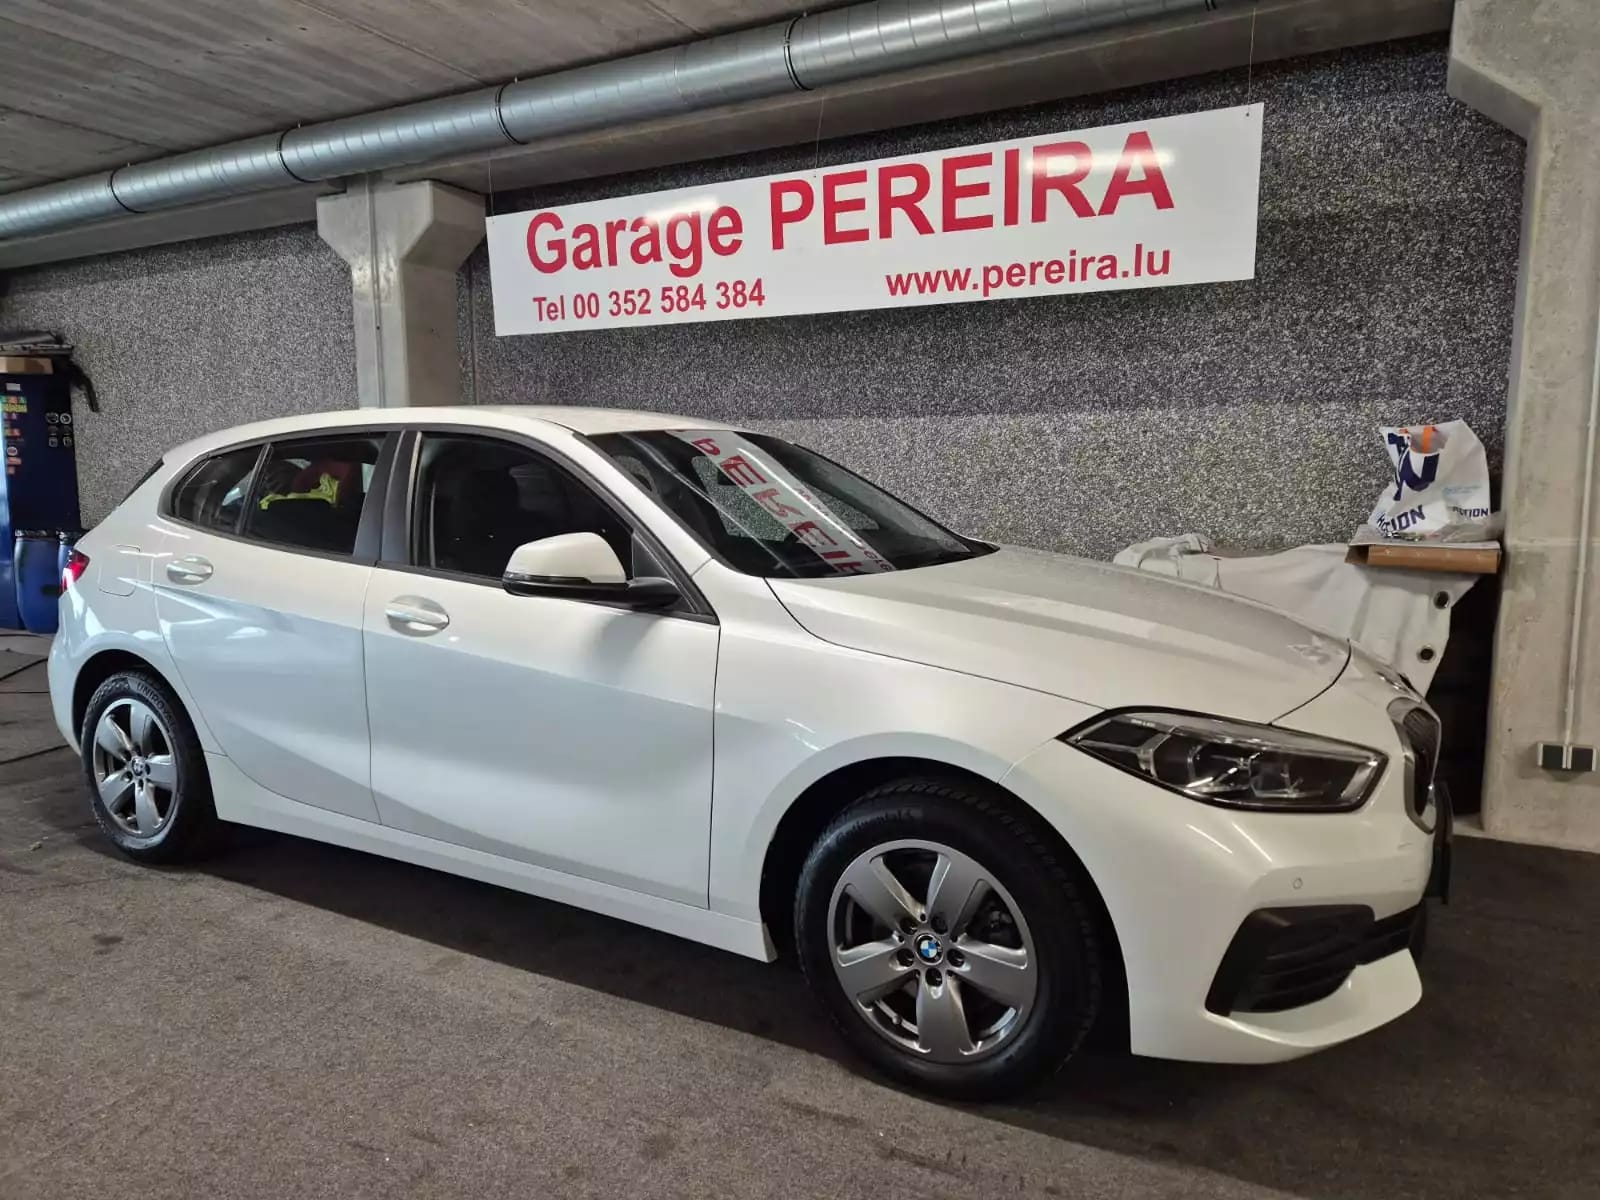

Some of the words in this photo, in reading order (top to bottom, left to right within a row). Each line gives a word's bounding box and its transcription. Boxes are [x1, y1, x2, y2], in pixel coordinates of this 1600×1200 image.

[527, 205, 743, 276] Garage
[770, 131, 1174, 250] PEREIRA
[886, 243, 1171, 297] www.pereira.lu
[533, 295, 566, 320] Tel
[573, 293, 600, 319] 00
[608, 288, 652, 317] 352
[661, 284, 706, 313] 584
[716, 278, 765, 309] 384
